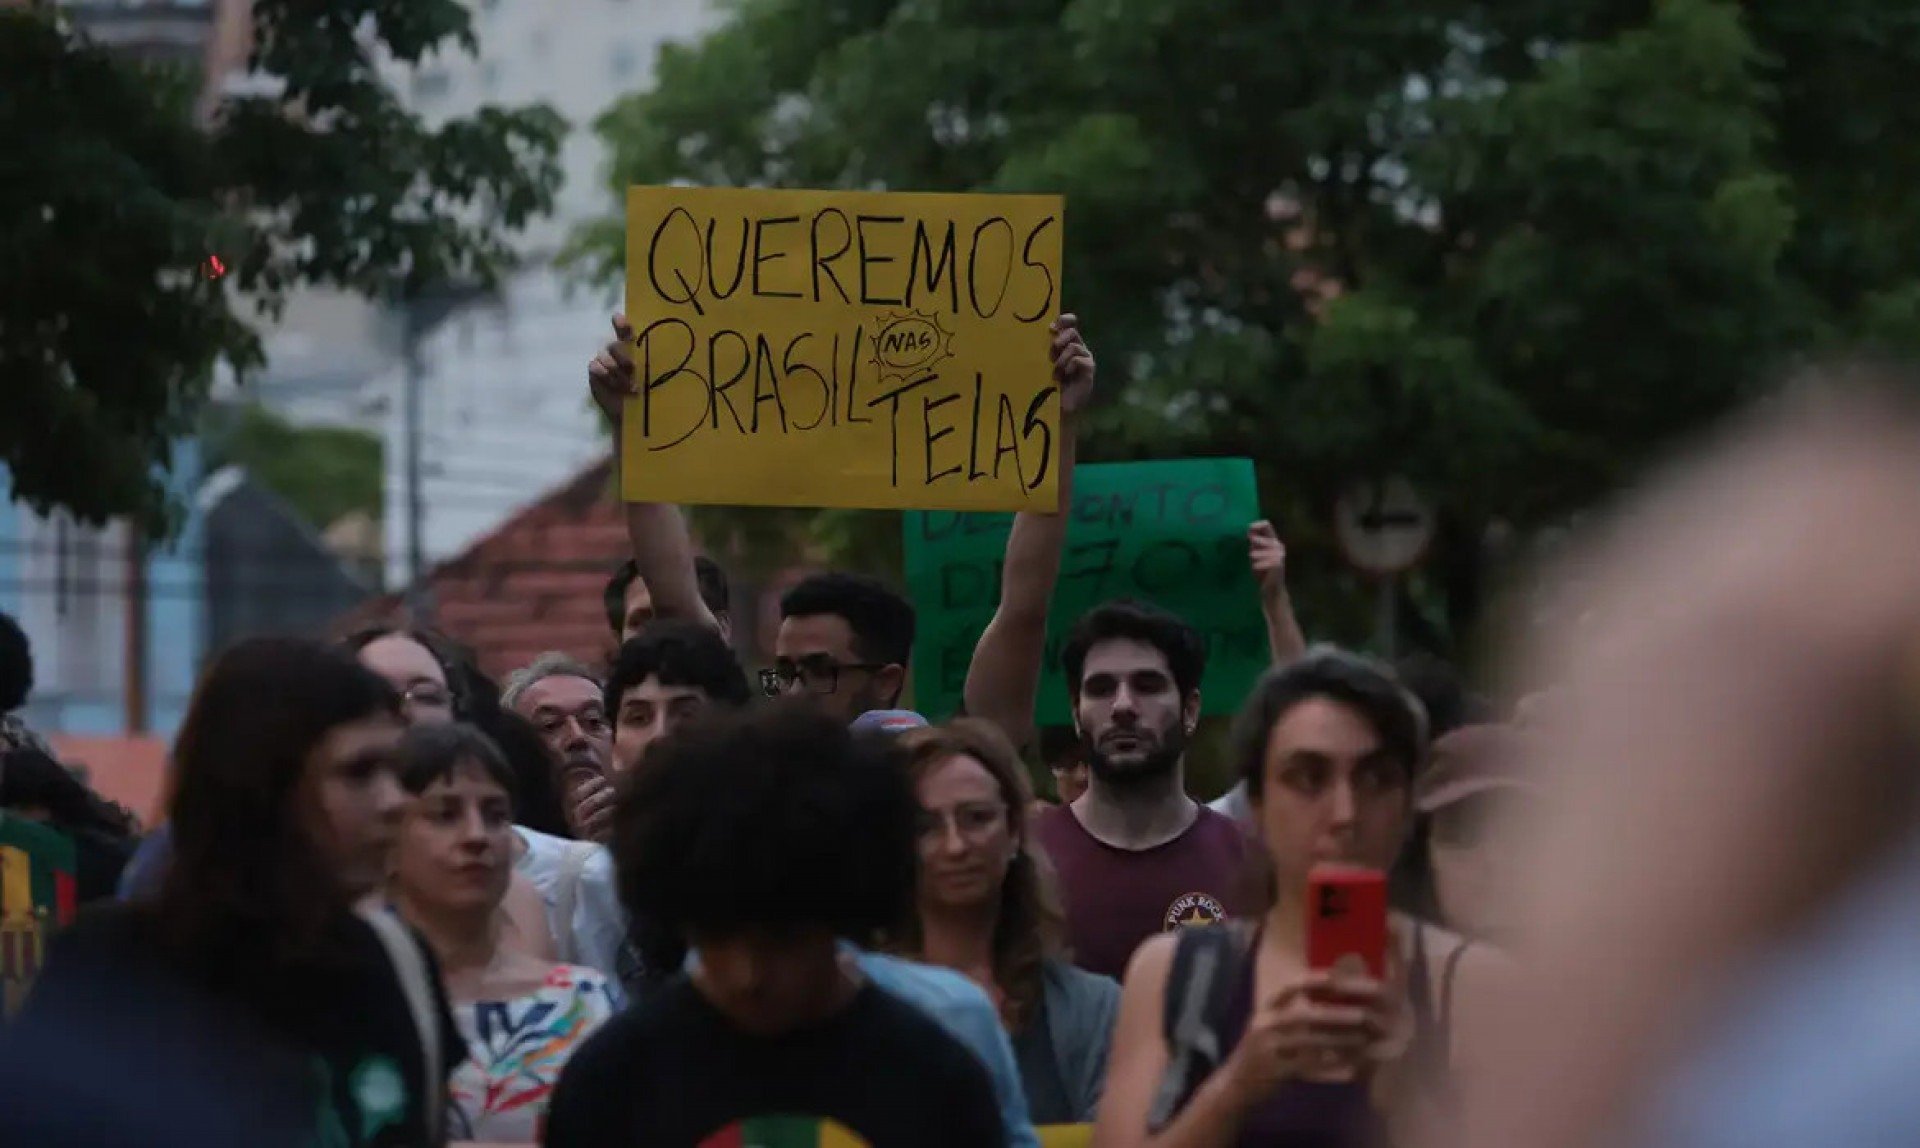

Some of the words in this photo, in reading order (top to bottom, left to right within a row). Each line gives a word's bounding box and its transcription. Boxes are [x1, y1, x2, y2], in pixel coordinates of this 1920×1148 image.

[648, 207, 1055, 322] QUEREMOS
[636, 318, 873, 451] BRASIL
[881, 330, 932, 354] NAS
[868, 372, 1058, 498] TELAS
[1167, 896, 1196, 923] PUNK
[1197, 896, 1223, 922] ROCK
